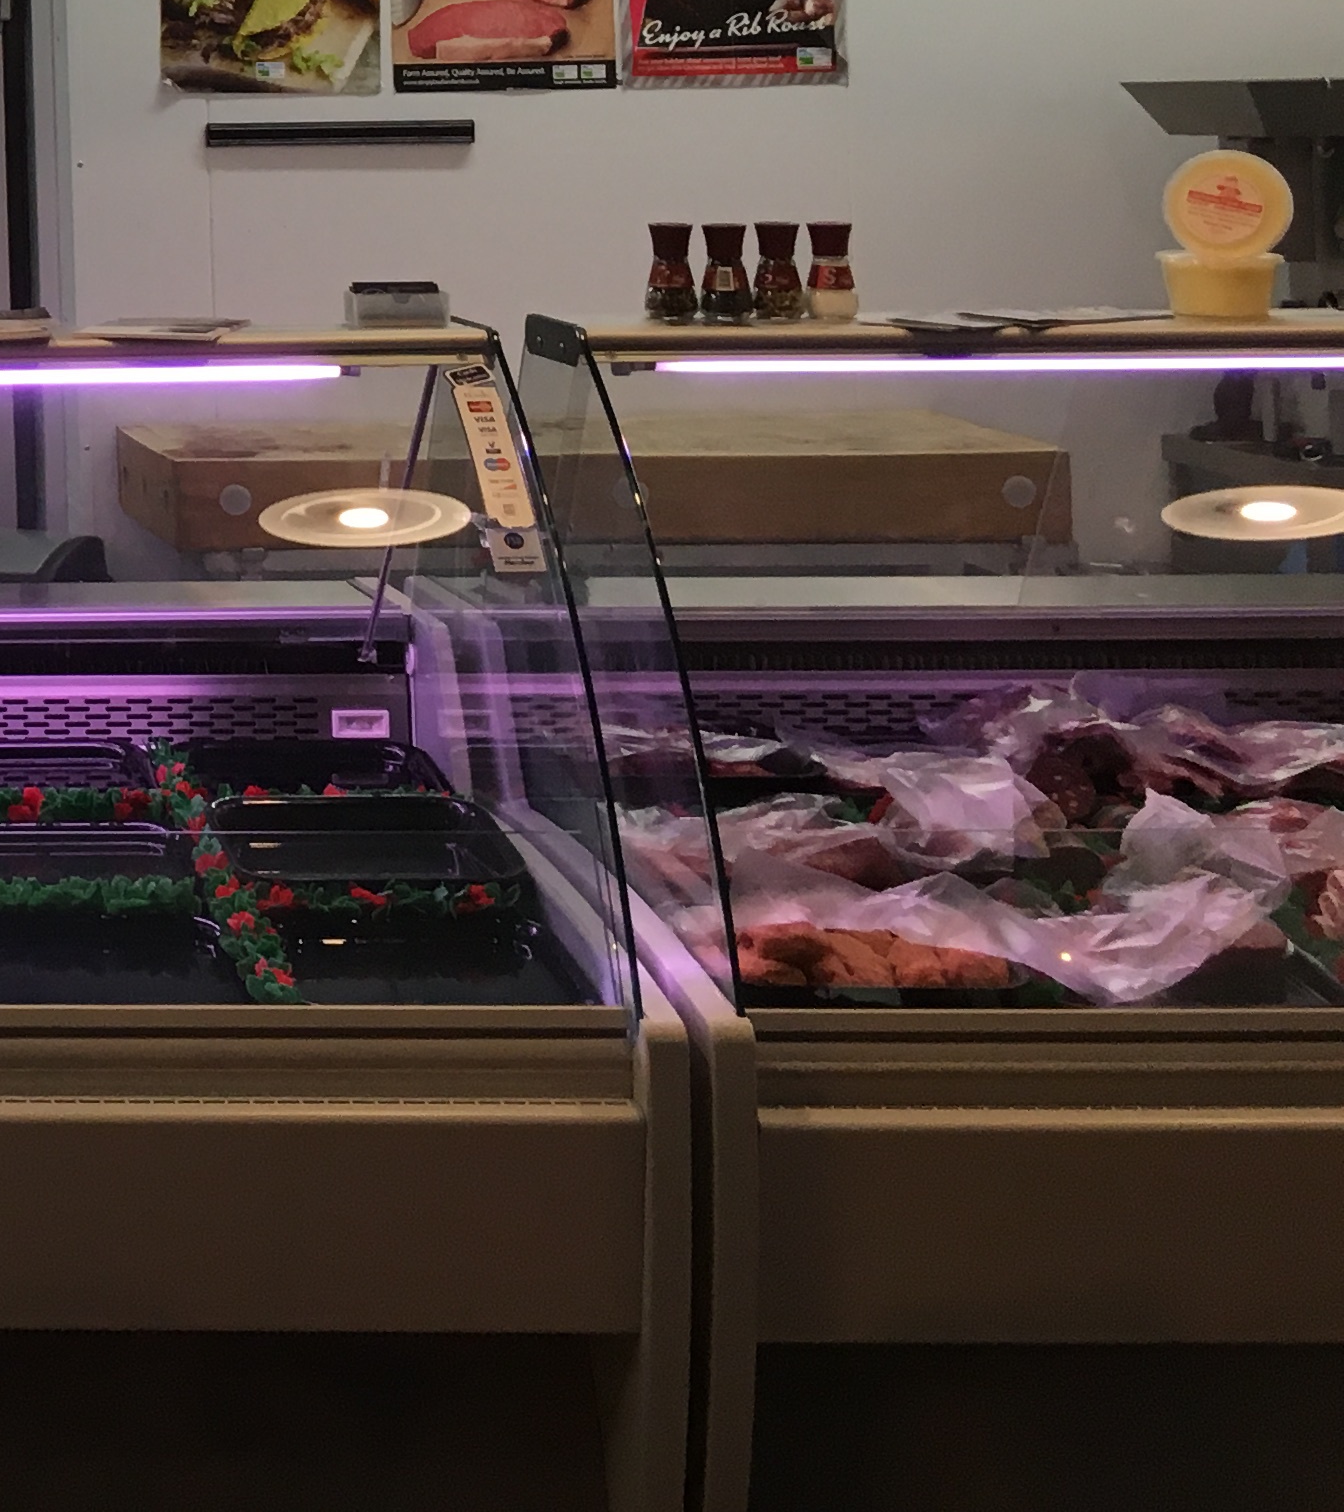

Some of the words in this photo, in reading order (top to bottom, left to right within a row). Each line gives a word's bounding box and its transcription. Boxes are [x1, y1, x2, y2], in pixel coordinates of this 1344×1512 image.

[642, 20, 705, 52] Enjoy
[709, 28, 722, 38] a
[726, 12, 762, 37] Rib
[766, 8, 827, 34] Roast
[474, 415, 496, 423] VISA
